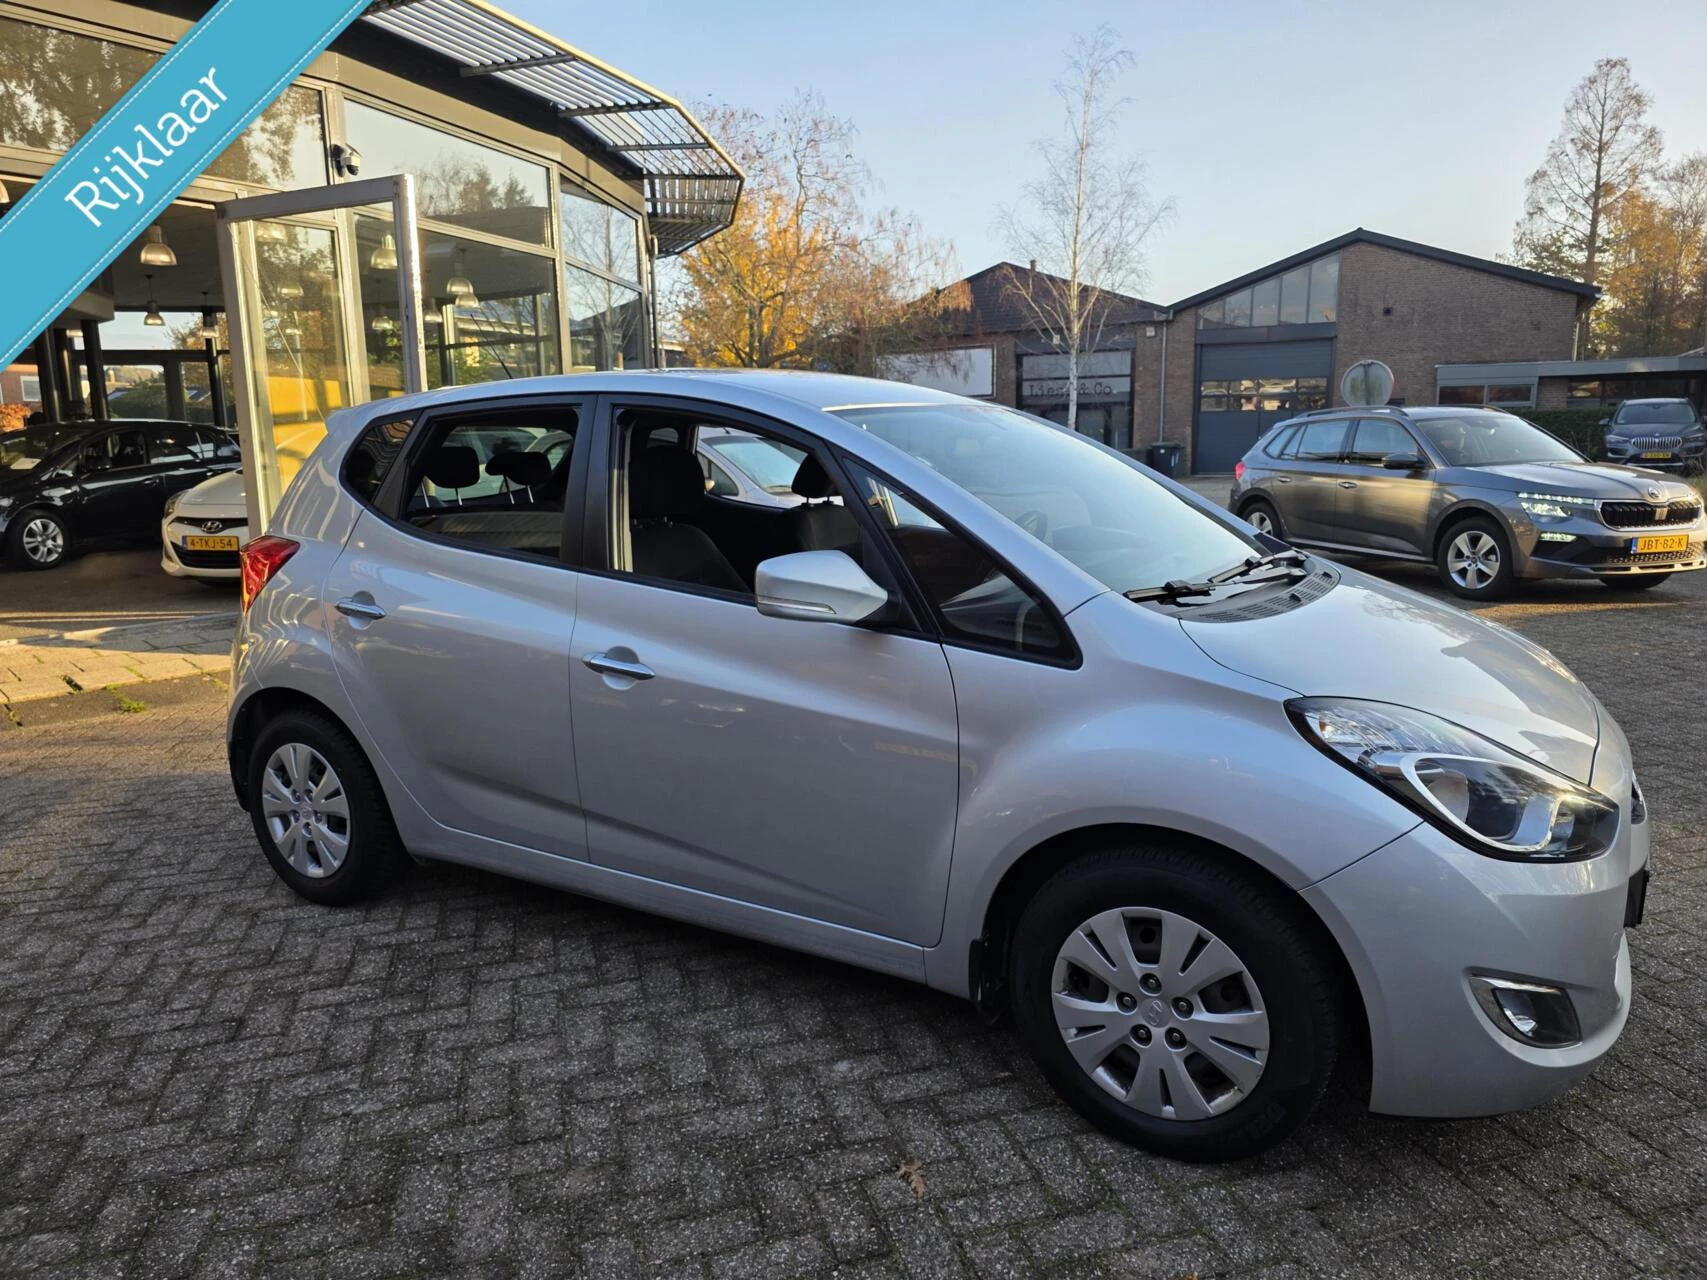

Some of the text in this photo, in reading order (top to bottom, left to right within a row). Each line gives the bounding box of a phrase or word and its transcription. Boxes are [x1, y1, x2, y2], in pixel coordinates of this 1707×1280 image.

[1079, 383, 1088, 395] &
[190, 538, 232, 548] 4-TKJ-54
[1640, 538, 1683, 550] JBT-82-K
